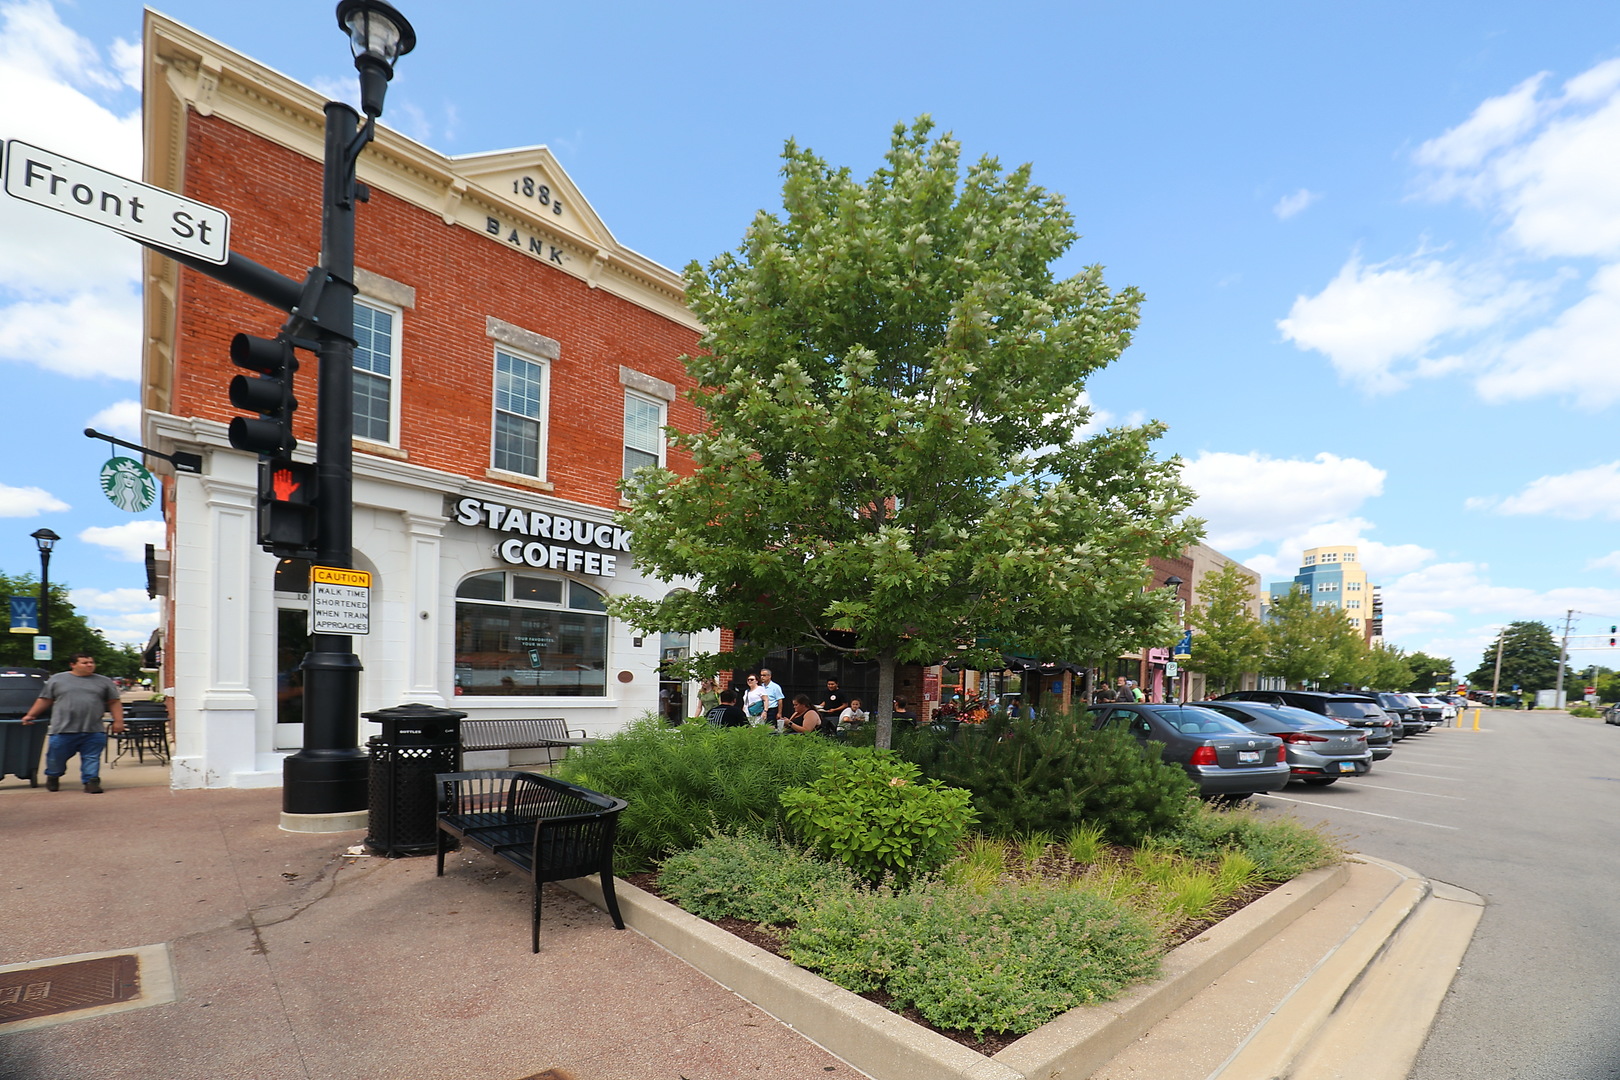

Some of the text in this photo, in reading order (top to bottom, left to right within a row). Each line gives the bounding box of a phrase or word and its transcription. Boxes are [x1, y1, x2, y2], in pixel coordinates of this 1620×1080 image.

[25, 158, 212, 245] Front St
[513, 176, 562, 215] 1885
[486, 217, 563, 265] BANK
[457, 498, 633, 552] STARBUCK
[501, 538, 617, 577] COFFEE
[318, 572, 366, 583] CAUTION
[318, 587, 366, 598] WALK TIME
[12, 601, 36, 614] W
[316, 599, 367, 609] SHORTENED
[315, 609, 368, 619] WHEN TRAIN
[316, 621, 367, 630] APPROACHES
